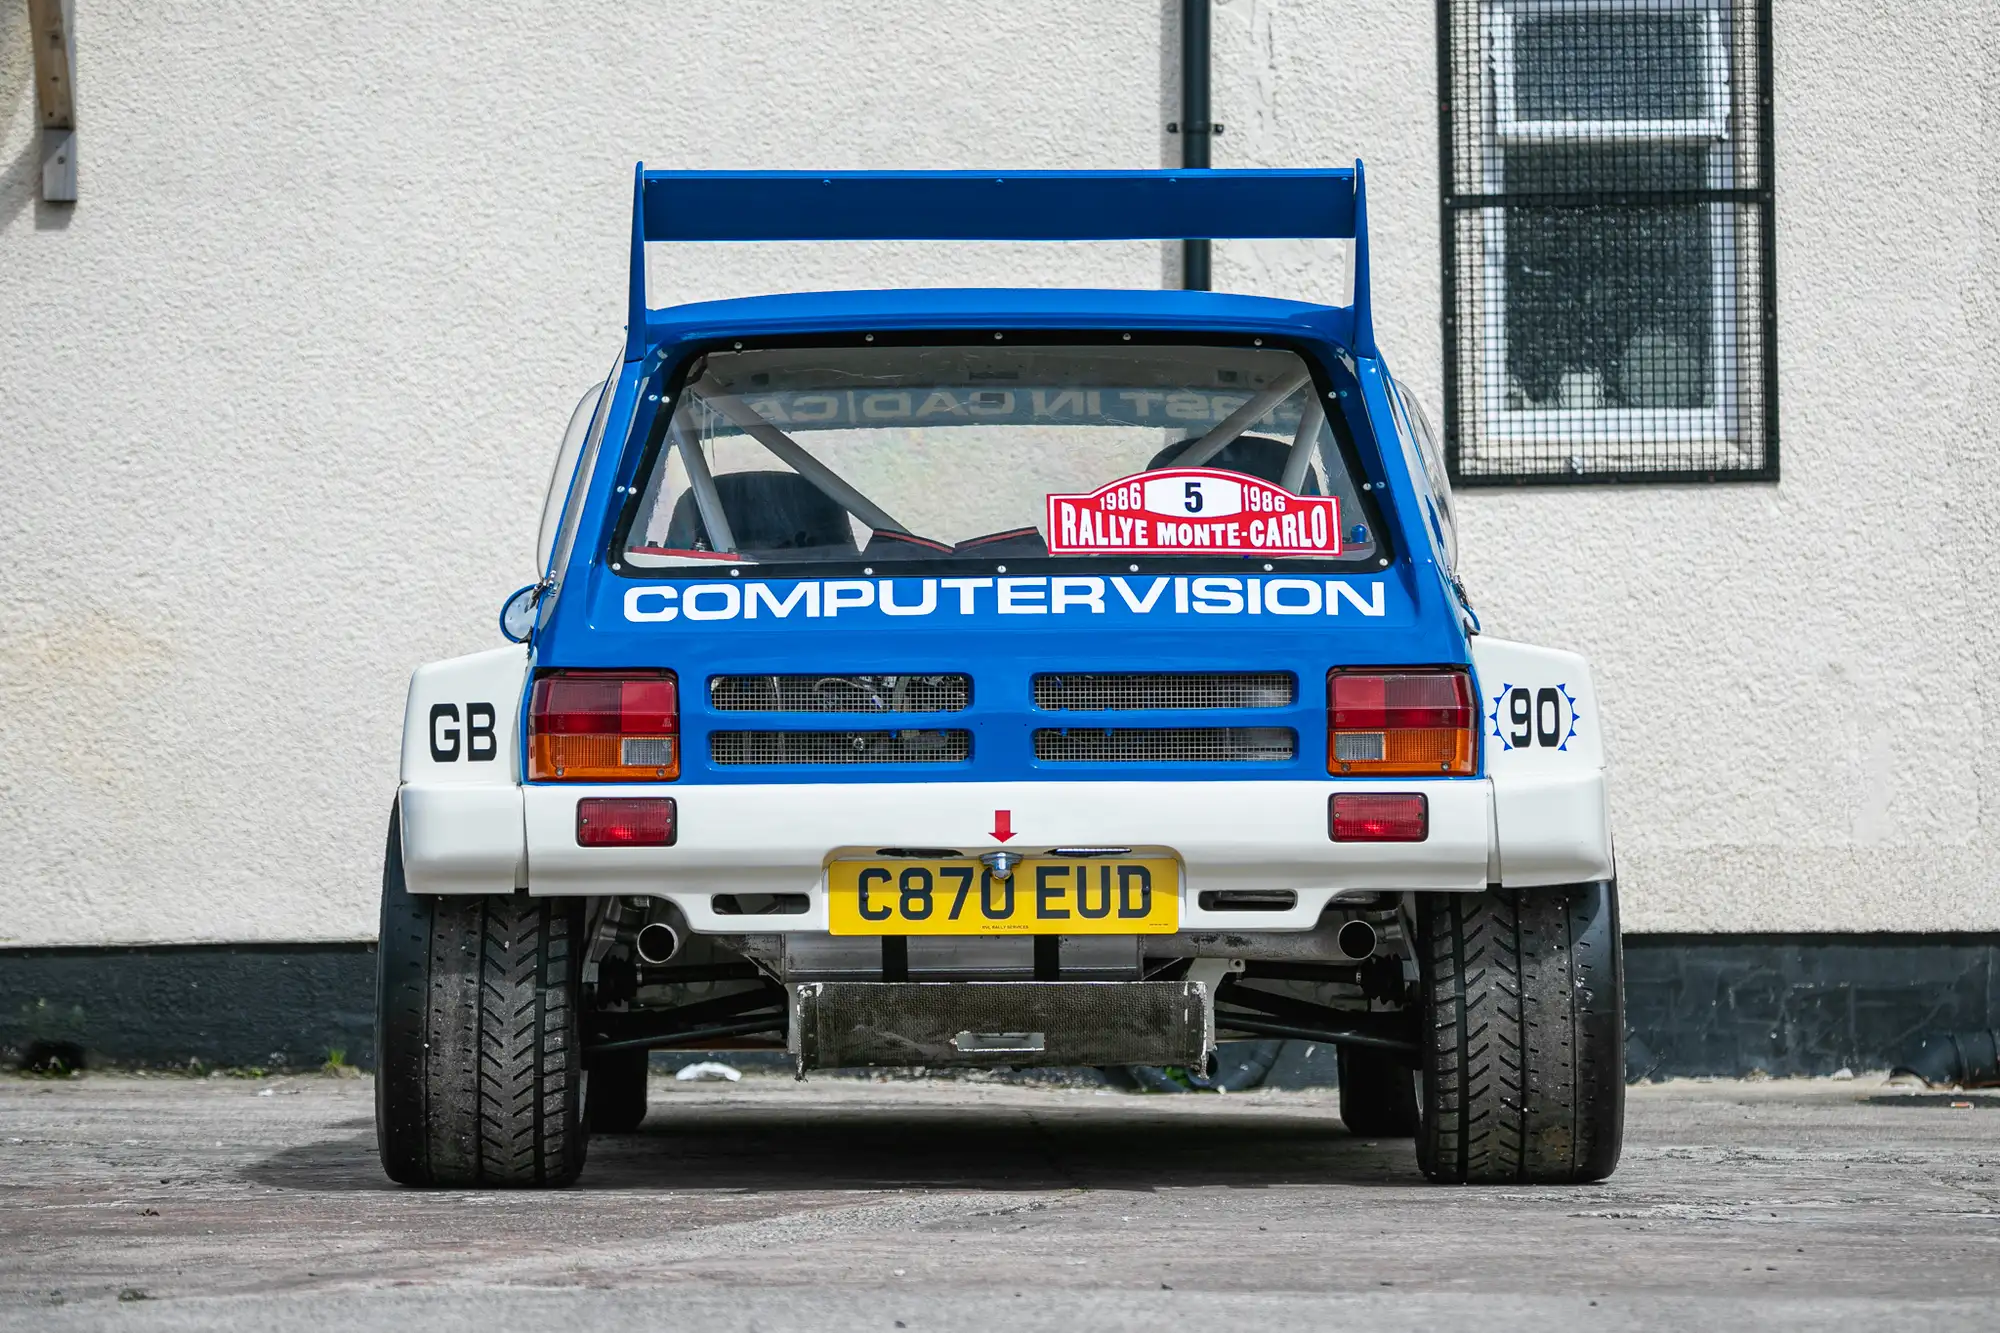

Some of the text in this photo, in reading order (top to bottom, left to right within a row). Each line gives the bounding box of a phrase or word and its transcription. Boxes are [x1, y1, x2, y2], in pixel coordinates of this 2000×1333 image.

[1100, 482, 1286, 513] 1986 5 1986
[1061, 501, 1328, 549] RALLYE MONTE-CARLO
[624, 577, 1385, 622] COMPUTERVISION
[429, 702, 497, 762] GB
[1510, 687, 1560, 748] 90
[858, 865, 1151, 921] C870 EUD
